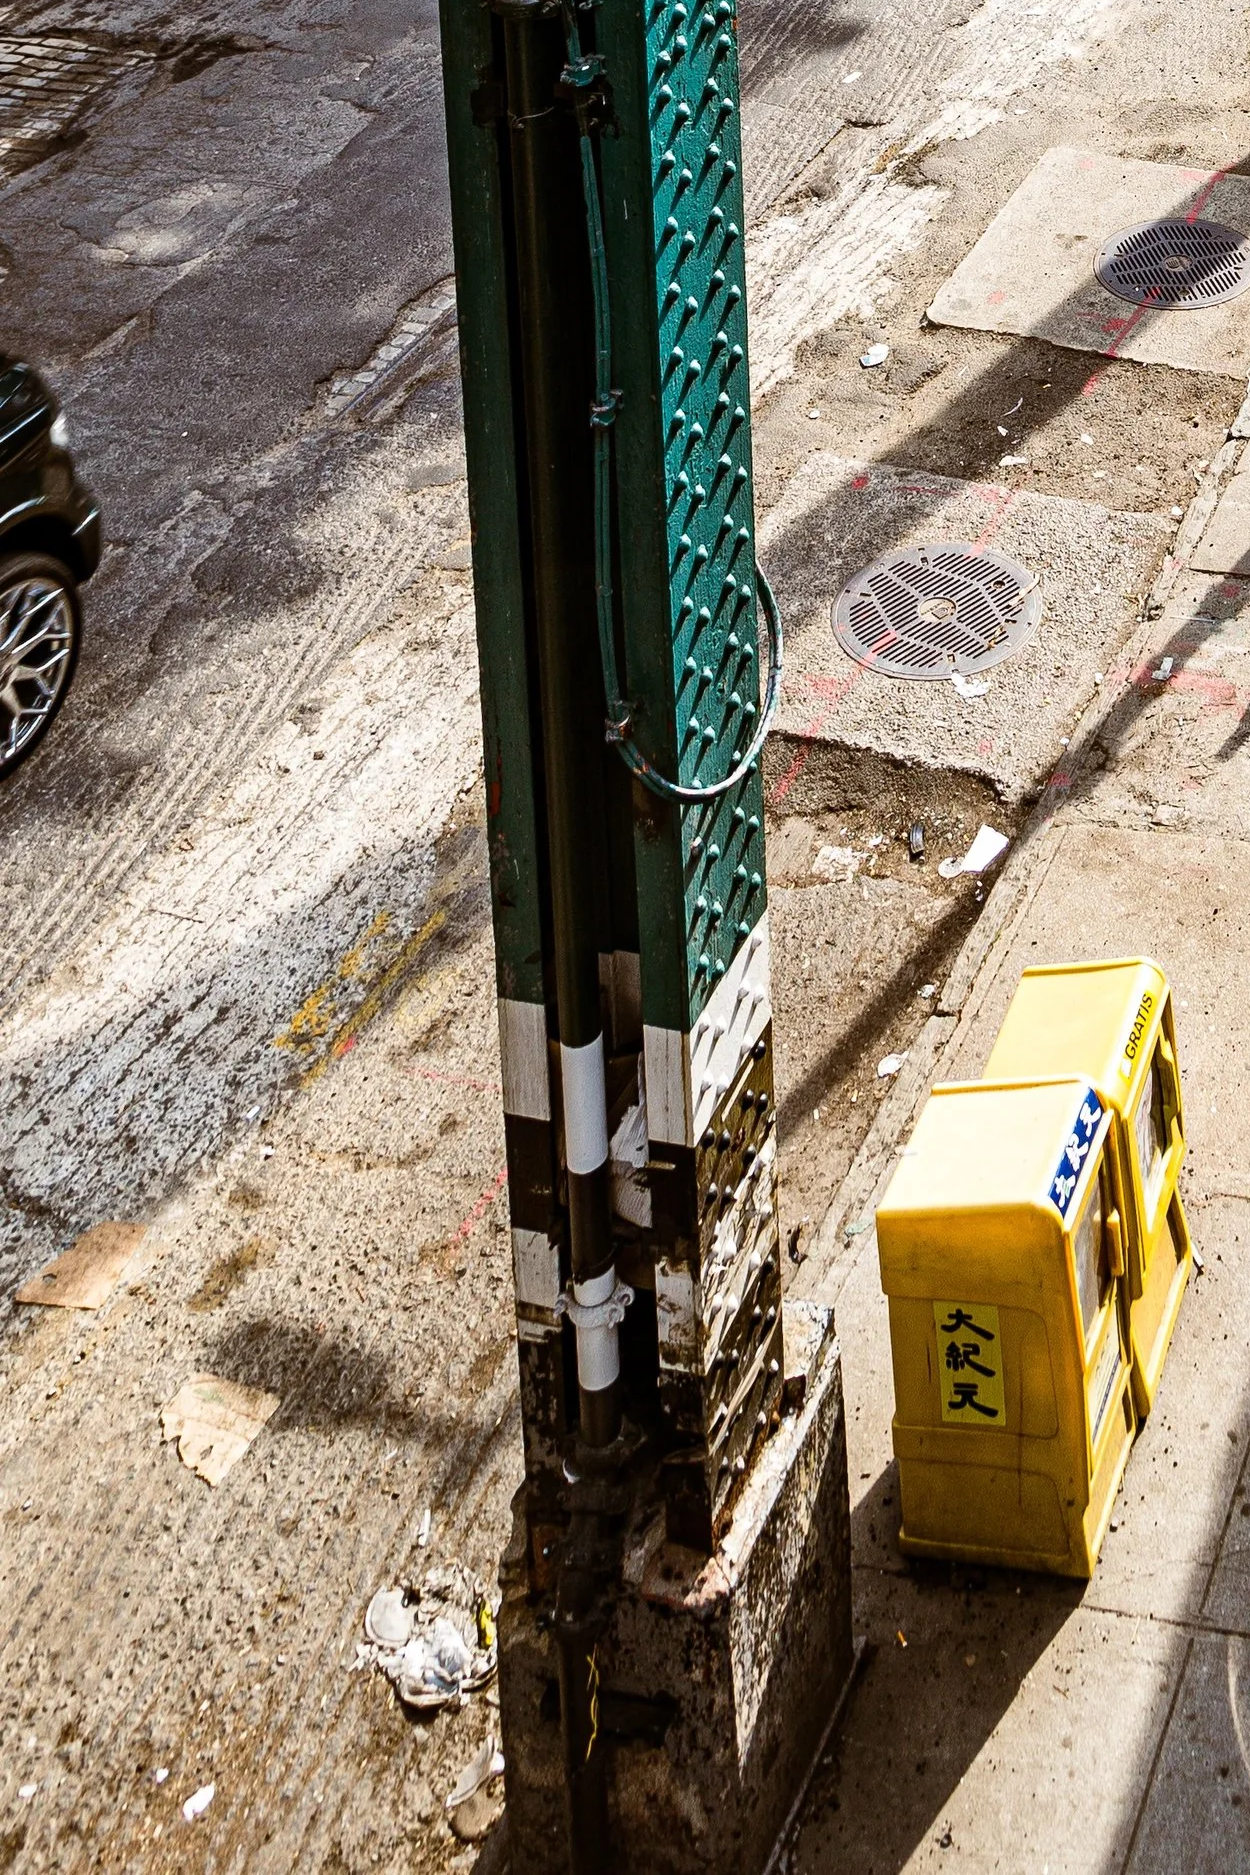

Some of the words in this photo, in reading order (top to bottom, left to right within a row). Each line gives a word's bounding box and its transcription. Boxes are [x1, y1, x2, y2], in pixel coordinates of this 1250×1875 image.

[1124, 993, 1154, 1060] GRATIS
[940, 1308, 999, 1418] 大紀元
